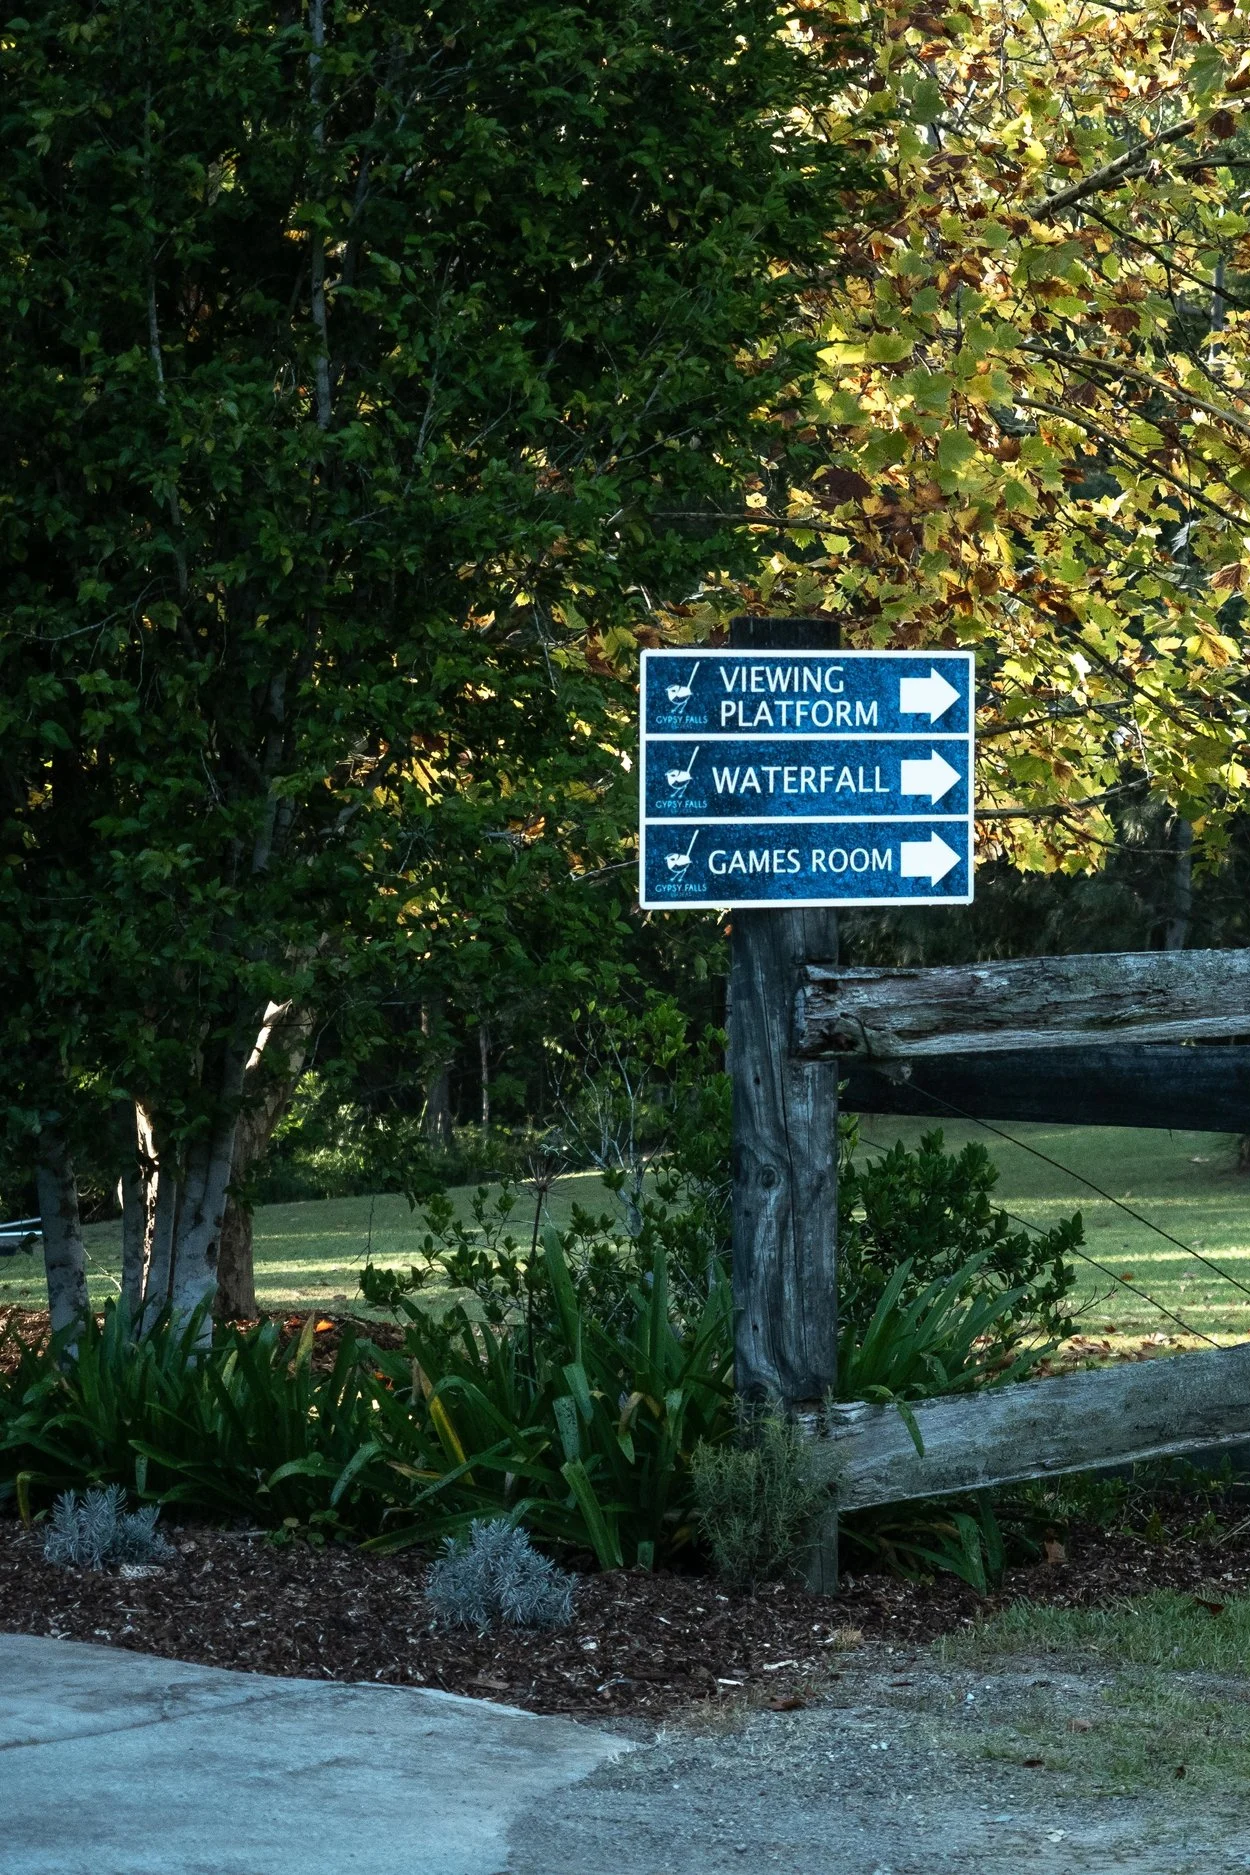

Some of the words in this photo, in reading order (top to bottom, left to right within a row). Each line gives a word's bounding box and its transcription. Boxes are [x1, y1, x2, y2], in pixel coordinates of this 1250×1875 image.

[720, 666, 844, 693] VIEWING
[655, 715, 683, 724] GYPSY
[685, 715, 708, 724] FALLS
[720, 700, 878, 727] PLATFORM
[712, 766, 890, 793] WATERFALL
[655, 800, 683, 808] GYPSY
[684, 800, 707, 808] FALLS
[708, 849, 800, 873] GAMES
[812, 848, 892, 872] ROOM
[655, 884, 682, 892] GYPSY
[684, 883, 707, 892] FALLS
